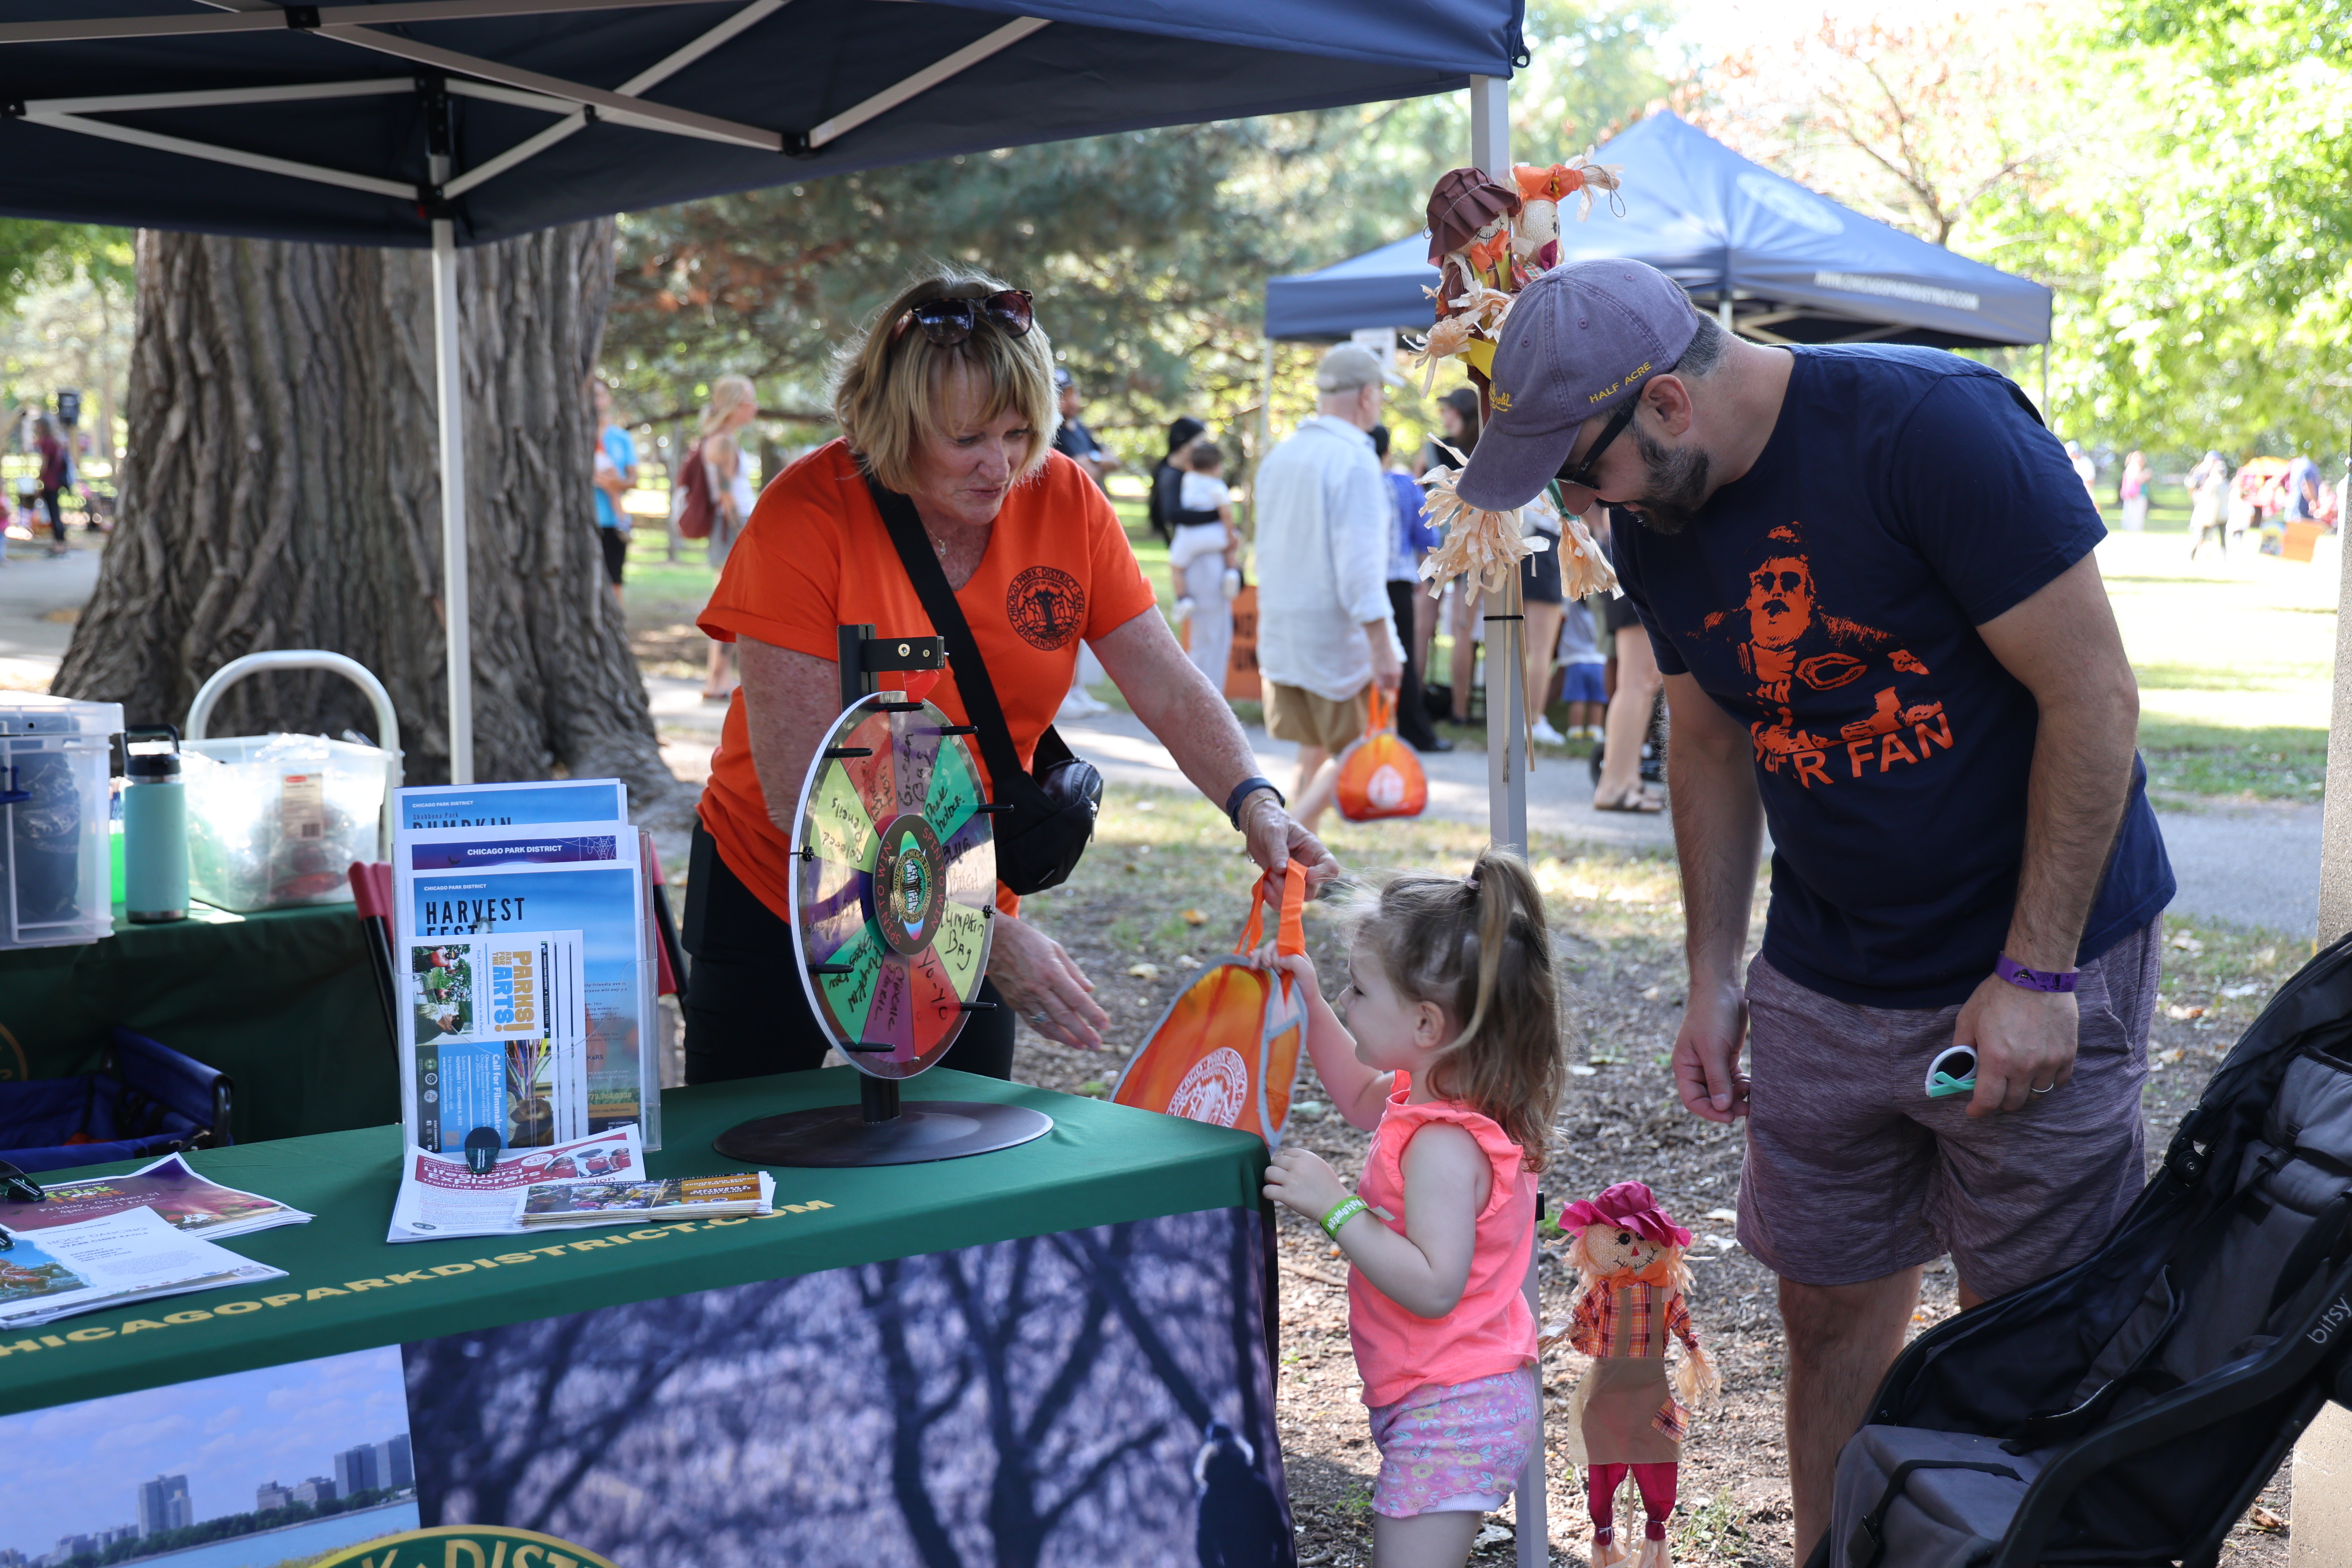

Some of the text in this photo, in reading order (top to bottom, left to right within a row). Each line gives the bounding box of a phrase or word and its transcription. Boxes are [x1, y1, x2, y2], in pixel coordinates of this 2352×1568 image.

[1589, 362, 1651, 403] HALF ACRE
[1009, 568, 1084, 622] CHICAGO PARK DISTRICT SEAL
[1018, 625, 1062, 649] ORGANIZED
[1847, 712, 1953, 778] FAN
[907, 849, 924, 863] CHICAGO
[894, 855, 906, 892] ORGANIZ
[922, 828, 945, 929] SPIN TO WIN
[877, 841, 901, 945] SPIN TO WIN
[920, 887, 932, 917] DISTRICT
[426, 897, 525, 924] HARVEST
[909, 913, 920, 923] SEAL
[494, 1087, 503, 1136] Filmmaker
[422, 1178, 528, 1189] Training Program
[424, 1166, 523, 1179] Lifeguard
[428, 1171, 541, 1184] Explorers
[46, 1186, 114, 1198] Trick
[46, 1190, 125, 1203] Treat
[94, 1195, 143, 1204] October
[60, 1205, 114, 1213] 4pm-6pm
[1326, 1199, 1364, 1230] HALLOWEEN
[47, 1227, 148, 1245] HOOP DANCING
[74, 1249, 114, 1258] NOVEMBER
[0, 1200, 835, 1357] HICAGOPARKDISTRICT.COM
[2307, 1297, 2352, 1343] bitsy
